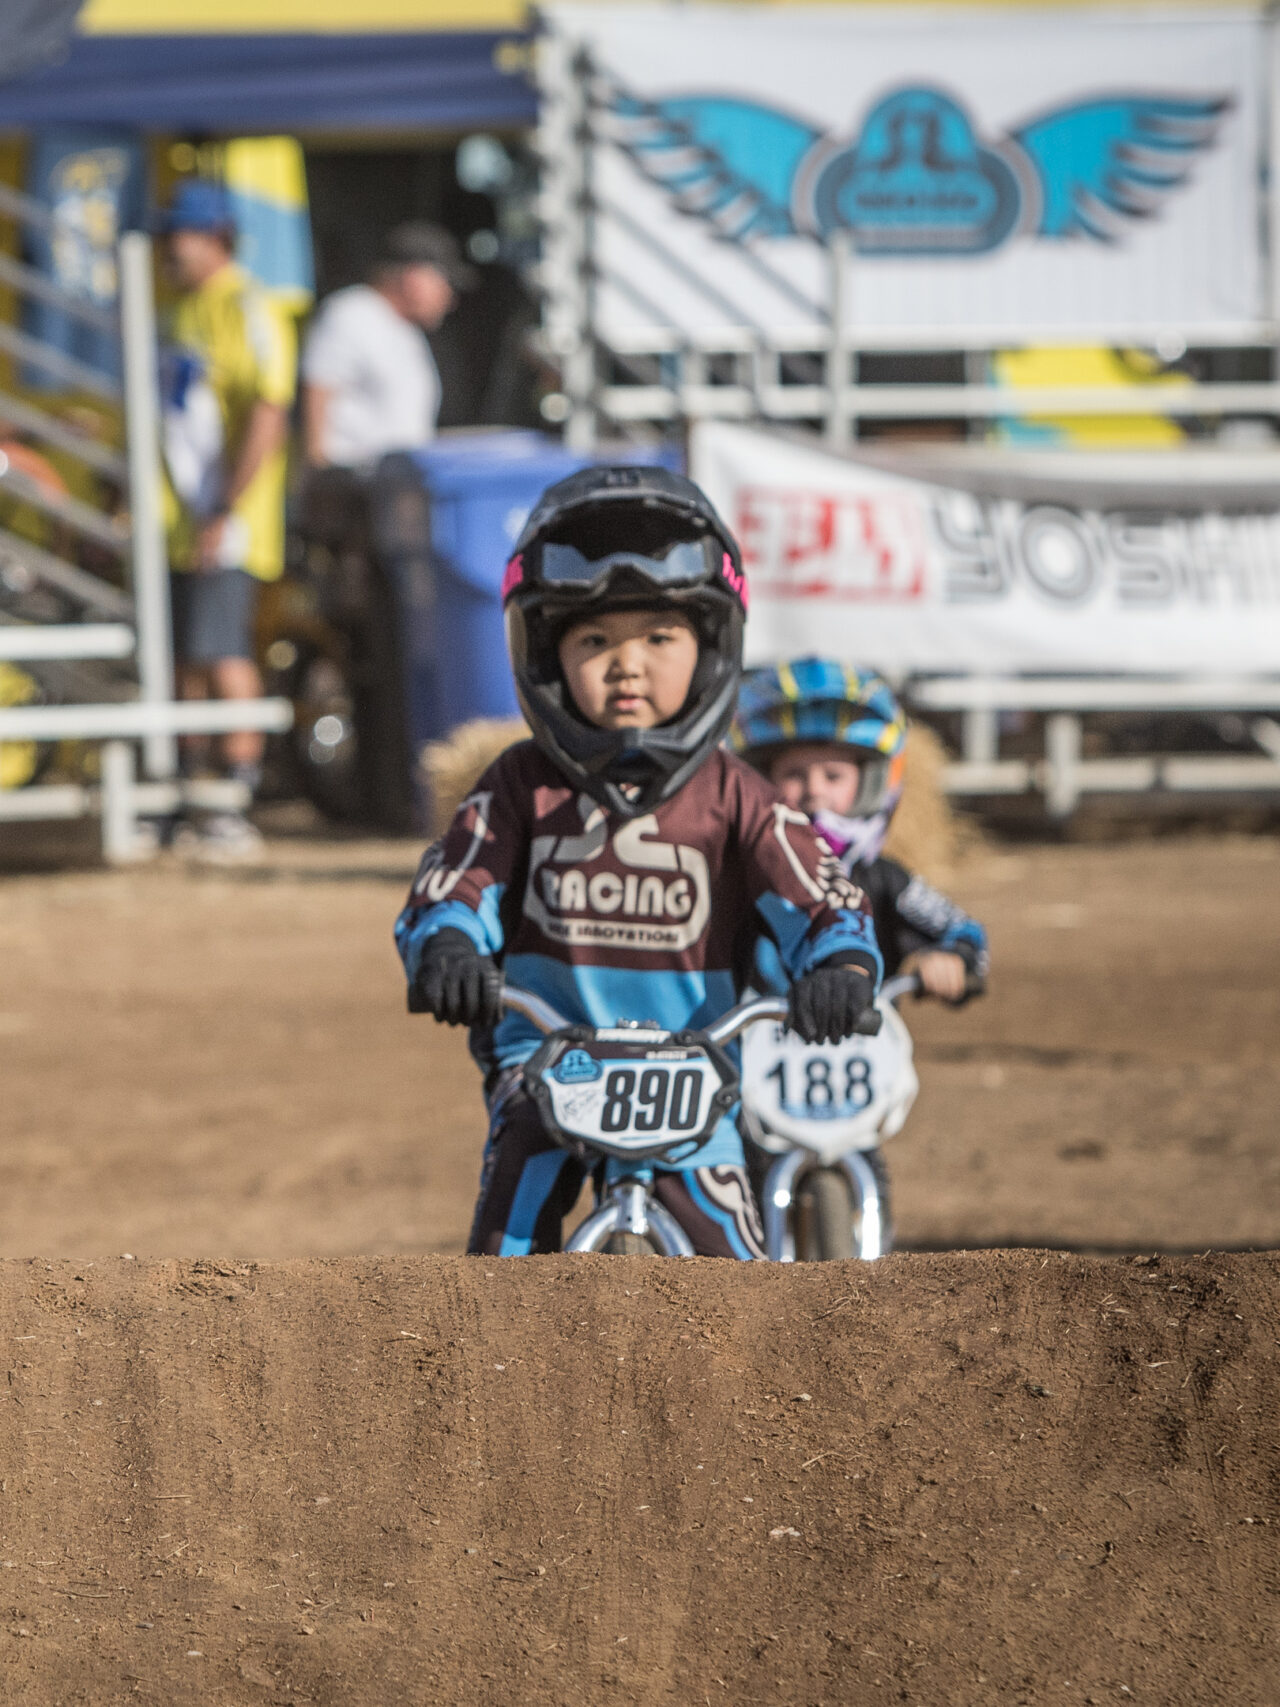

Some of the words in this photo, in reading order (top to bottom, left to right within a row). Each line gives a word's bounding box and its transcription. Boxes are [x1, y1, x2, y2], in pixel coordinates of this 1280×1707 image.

[540, 868, 694, 919] RACING
[600, 1068, 704, 1133] 890
[766, 1056, 874, 1112] 188
